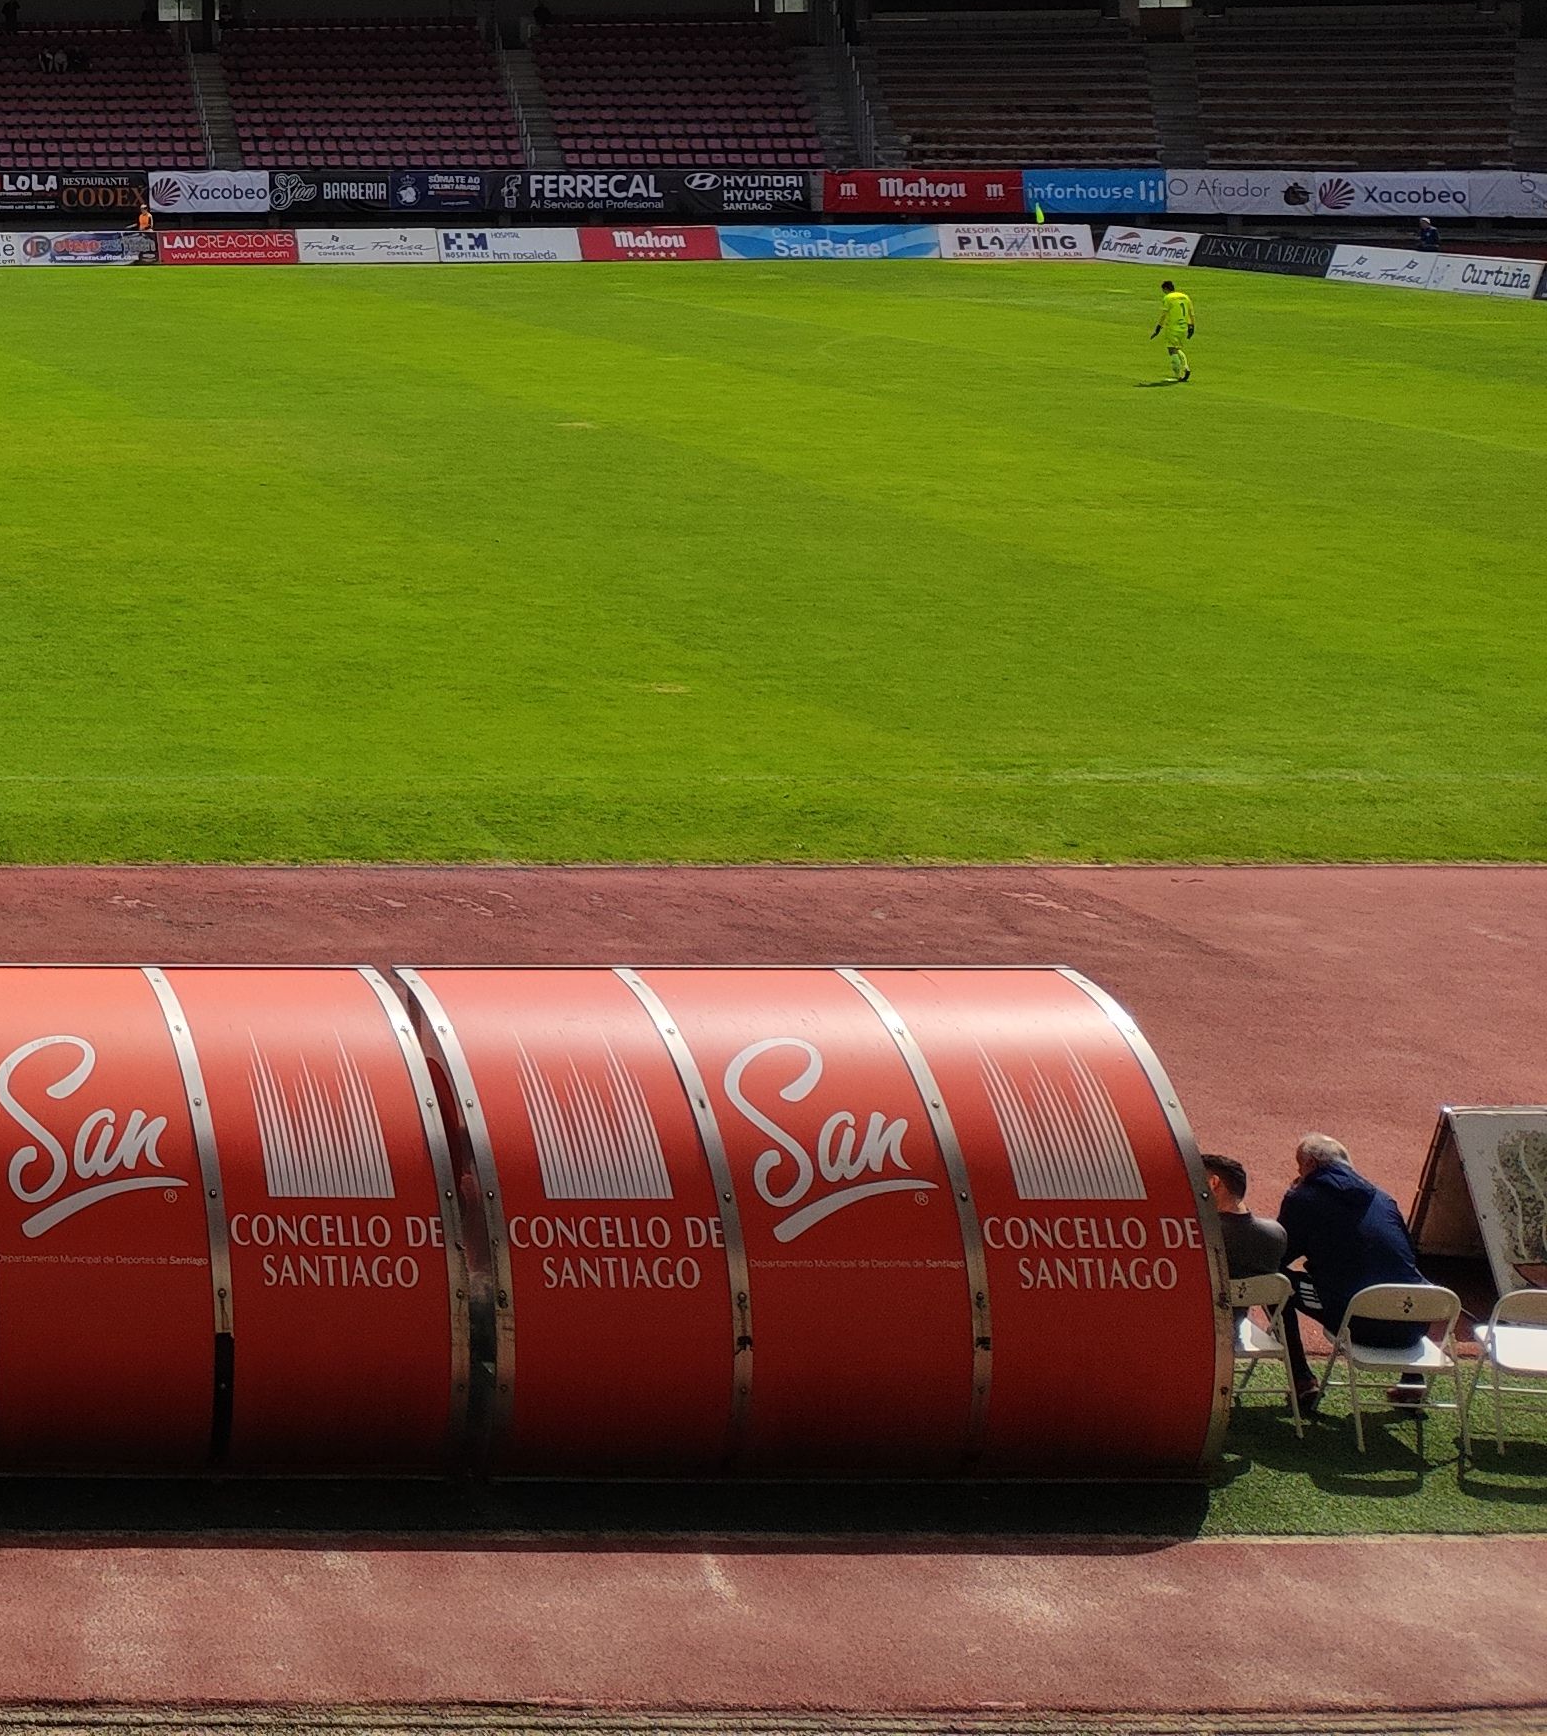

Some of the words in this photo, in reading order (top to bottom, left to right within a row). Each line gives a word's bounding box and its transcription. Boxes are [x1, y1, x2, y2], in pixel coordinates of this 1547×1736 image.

[62, 177, 129, 186] RESTAURANTE
[529, 174, 663, 197] FERRECAL
[723, 175, 800, 187] HYUNDAI
[879, 177, 967, 197] Mahou
[1168, 178, 1188, 196] O
[1196, 178, 1271, 197] Afiador
[62, 187, 147, 207] CODEX
[188, 184, 268, 201] Xacobeo
[323, 182, 387, 200] BARBERIA
[723, 189, 800, 202] HYUPERSA
[1027, 182, 1134, 200] inforhouse
[1363, 186, 1467, 204] Xacobeo
[544, 200, 585, 209] Servicio
[588, 200, 604, 209] del
[606, 199, 664, 209] Profesional
[722, 202, 773, 211] SANTIAGO
[491, 231, 520, 239] HOSPITAL
[612, 230, 687, 249] Mahou
[772, 228, 812, 239] Cobre
[171, 250, 289, 260] www.laucreaciones.com
[493, 250, 510, 260] hm
[513, 250, 557, 260] rosaleda
[774, 239, 889, 258] SanRafael
[1101, 239, 1143, 255] durmet
[1147, 243, 1188, 260] durmet
[1202, 238, 1260, 260] JESSICA
[1265, 244, 1331, 265] FABEIRO
[1461, 264, 1531, 289] Curtiña
[724, 1037, 911, 1208] San
[230, 1214, 391, 1247] CONCELLO
[406, 1216, 444, 1248] DE
[509, 1215, 672, 1249] CONCELLO
[685, 1216, 725, 1249] DE
[983, 1216, 1148, 1250] CONCELLO
[1162, 1217, 1204, 1249] DE
[60, 1254, 102, 1265] Municipal
[103, 1256, 115, 1264] de
[116, 1256, 156, 1266] Deportes
[157, 1256, 168, 1264] de
[170, 1256, 209, 1266] Santiago
[926, 1259, 965, 1270] Santiago
[263, 1255, 419, 1288] SANTIAGO
[543, 1256, 701, 1289] SANTIAGO
[1019, 1257, 1178, 1290] SANTIAGO
